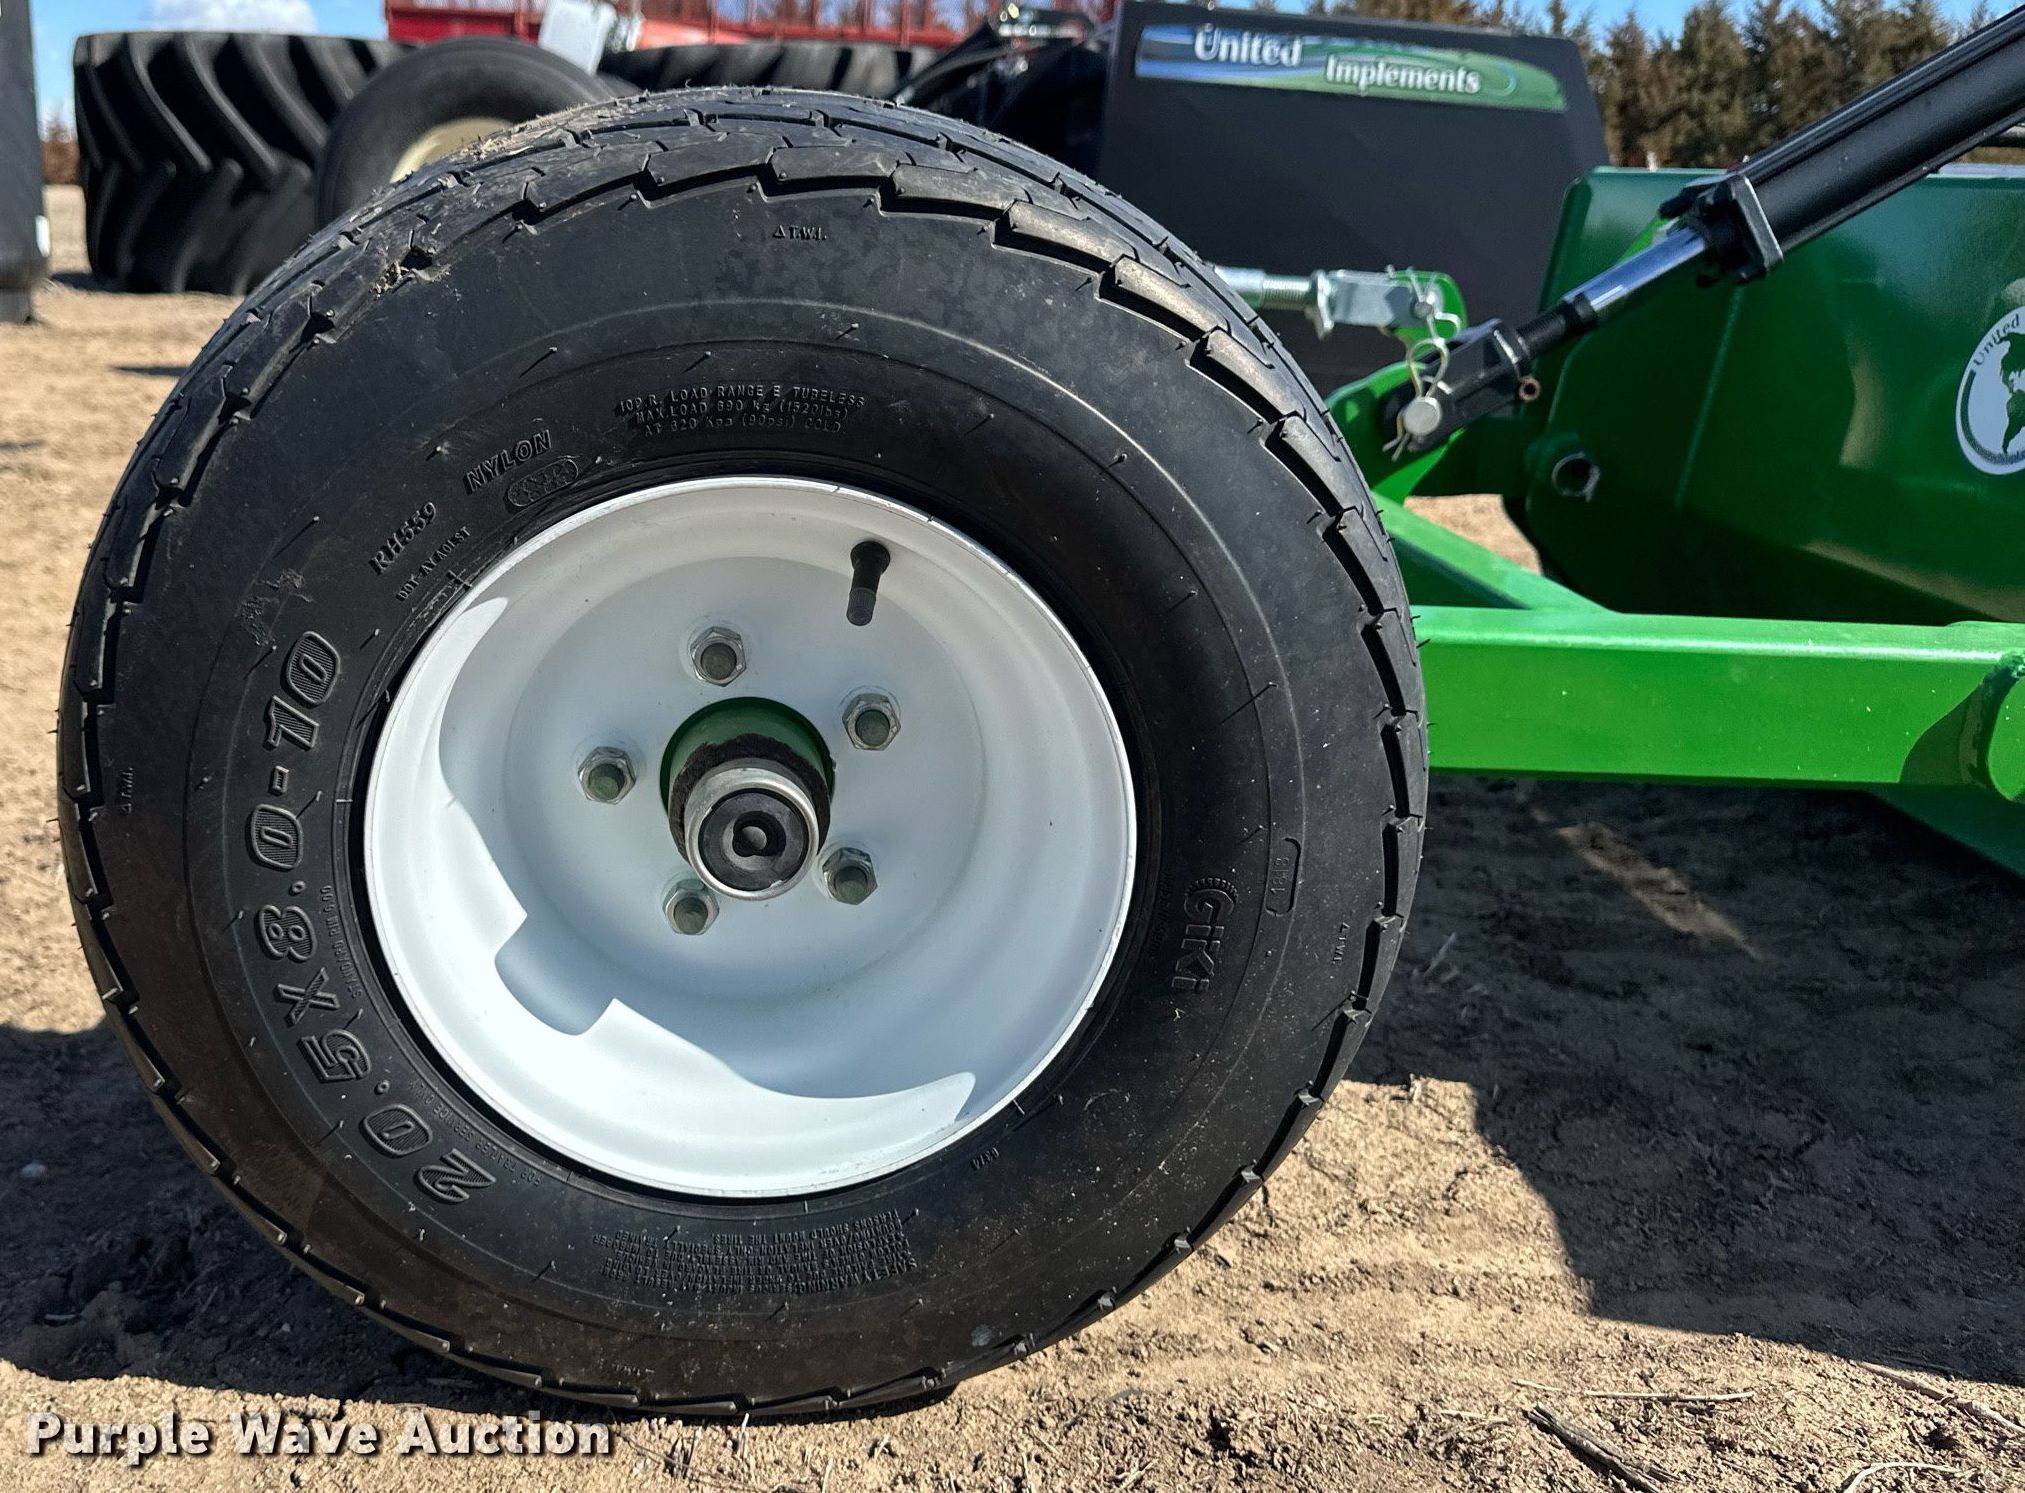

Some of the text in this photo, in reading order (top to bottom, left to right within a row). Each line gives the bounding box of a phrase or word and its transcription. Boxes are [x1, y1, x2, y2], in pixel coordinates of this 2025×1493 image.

[1194, 25, 1481, 96] United Implements
[1973, 313, 2020, 366] United
[669, 385, 708, 402] LOAD
[716, 384, 764, 397] RANGE
[772, 384, 782, 397] E
[791, 385, 866, 409] TUBELESS
[466, 429, 552, 493] NYLON
[370, 501, 438, 574] RH559
